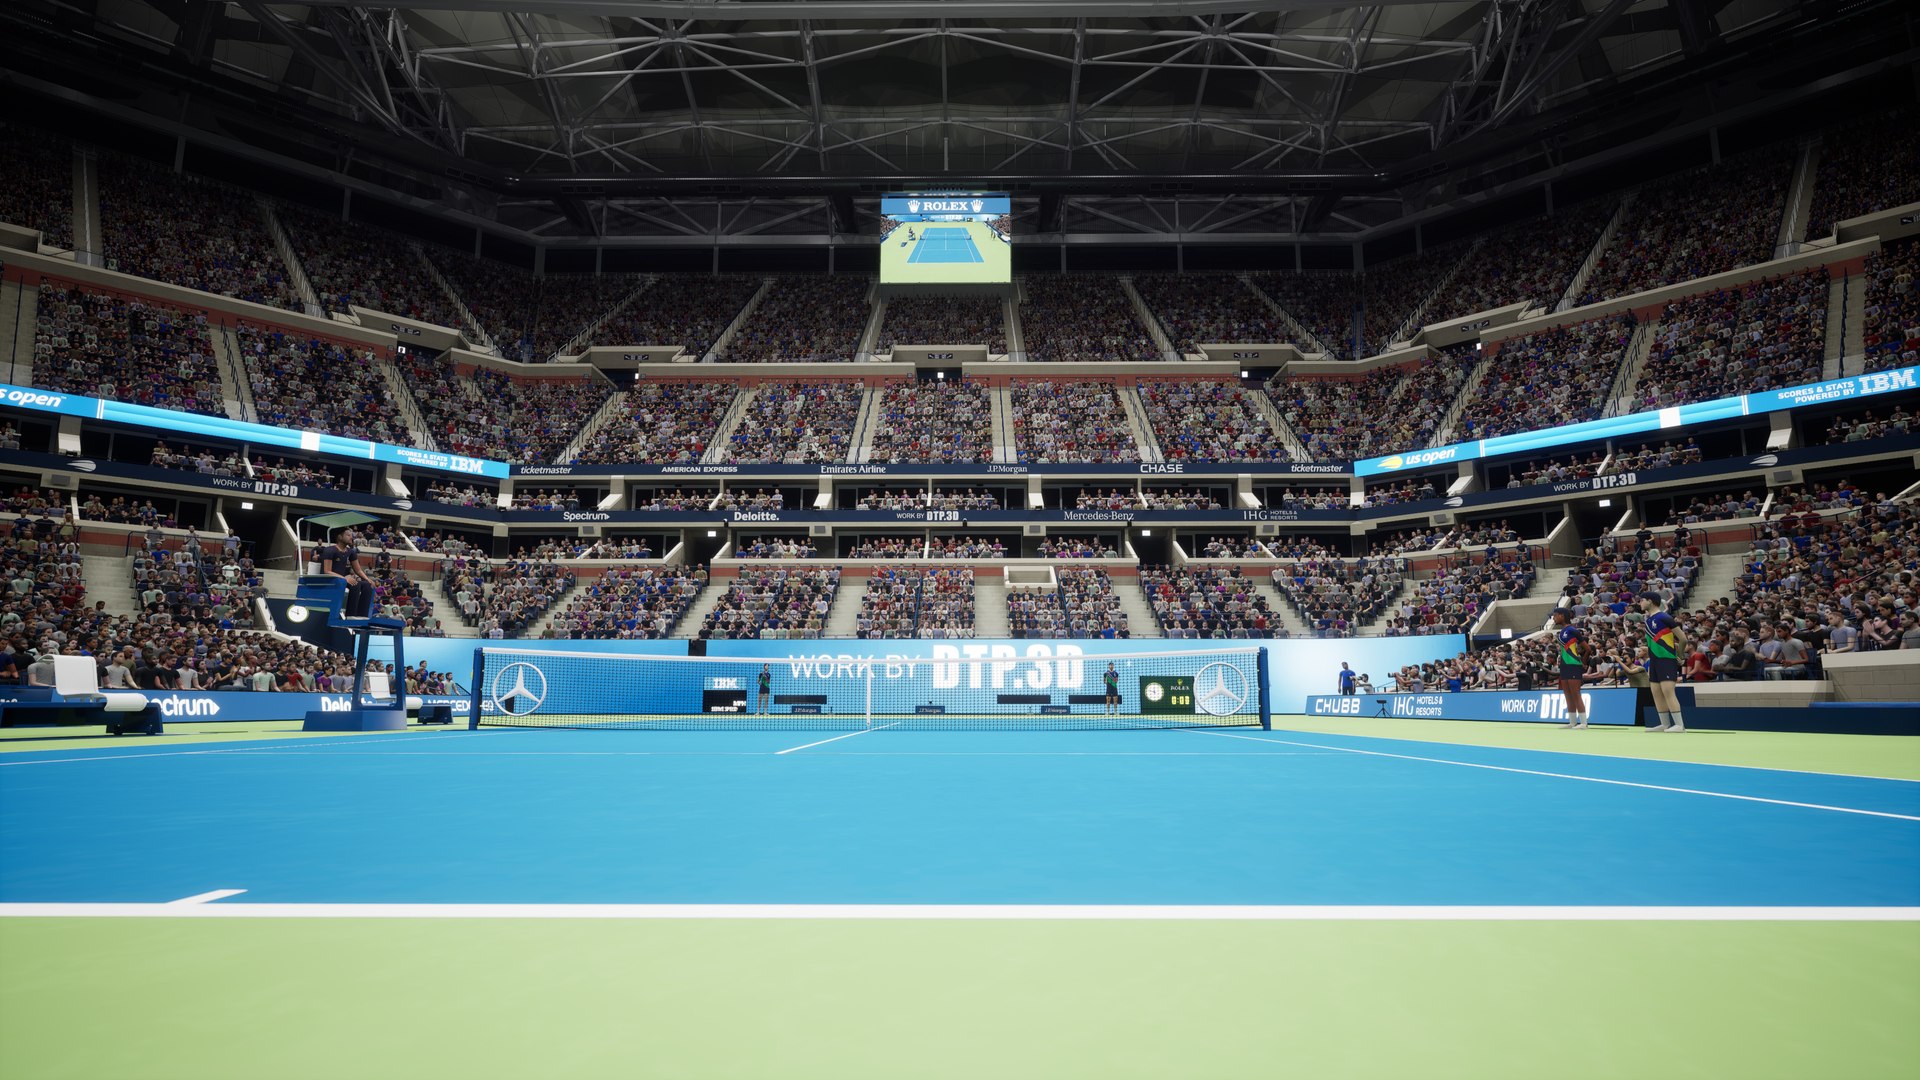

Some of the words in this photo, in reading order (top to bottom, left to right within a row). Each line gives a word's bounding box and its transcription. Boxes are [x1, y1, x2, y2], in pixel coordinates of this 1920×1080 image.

[923, 201, 968, 211] ROLEX
[1858, 368, 1917, 394] IBM
[1778, 387, 1814, 400] SCORES
[1826, 380, 1854, 392] STATS
[1795, 390, 1840, 404] POWERED
[1843, 388, 1855, 396] BY
[397, 449, 423, 458] SCORES
[430, 454, 448, 462] STATS
[1406, 454, 1421, 465] us
[408, 457, 438, 466] POWERED
[450, 456, 484, 474] IBM
[520, 466, 572, 474] ticketmaster
[821, 465, 857, 474] Emirates
[858, 465, 886, 474] Airline
[1140, 464, 1184, 473] CHASE
[1291, 464, 1344, 472] ticketmaster
[212, 478, 239, 487] WORK
[254, 481, 298, 496] DTP.3D
[1554, 483, 1578, 492] WORK
[1592, 472, 1636, 489] DTP.3D
[564, 512, 607, 522] Spectrum
[734, 511, 780, 521] Deloitte.
[896, 512, 914, 520] WORK
[916, 512, 924, 520] BY
[926, 511, 959, 521] DTP.3D
[1064, 511, 1134, 520] Mercedes-Benz
[1244, 510, 1268, 520] IHG
[789, 654, 876, 679] WORK
[886, 654, 921, 679] BY
[932, 644, 1084, 688] DTP.3D
[1416, 696, 1438, 704] HOTELS
[1316, 698, 1361, 714] CHUBB
[1393, 696, 1414, 716] IHG
[1501, 699, 1525, 712] WORK
[1527, 699, 1538, 712] BY
[1540, 693, 1591, 720] DTP.D
[1416, 708, 1442, 716] RESORTS
